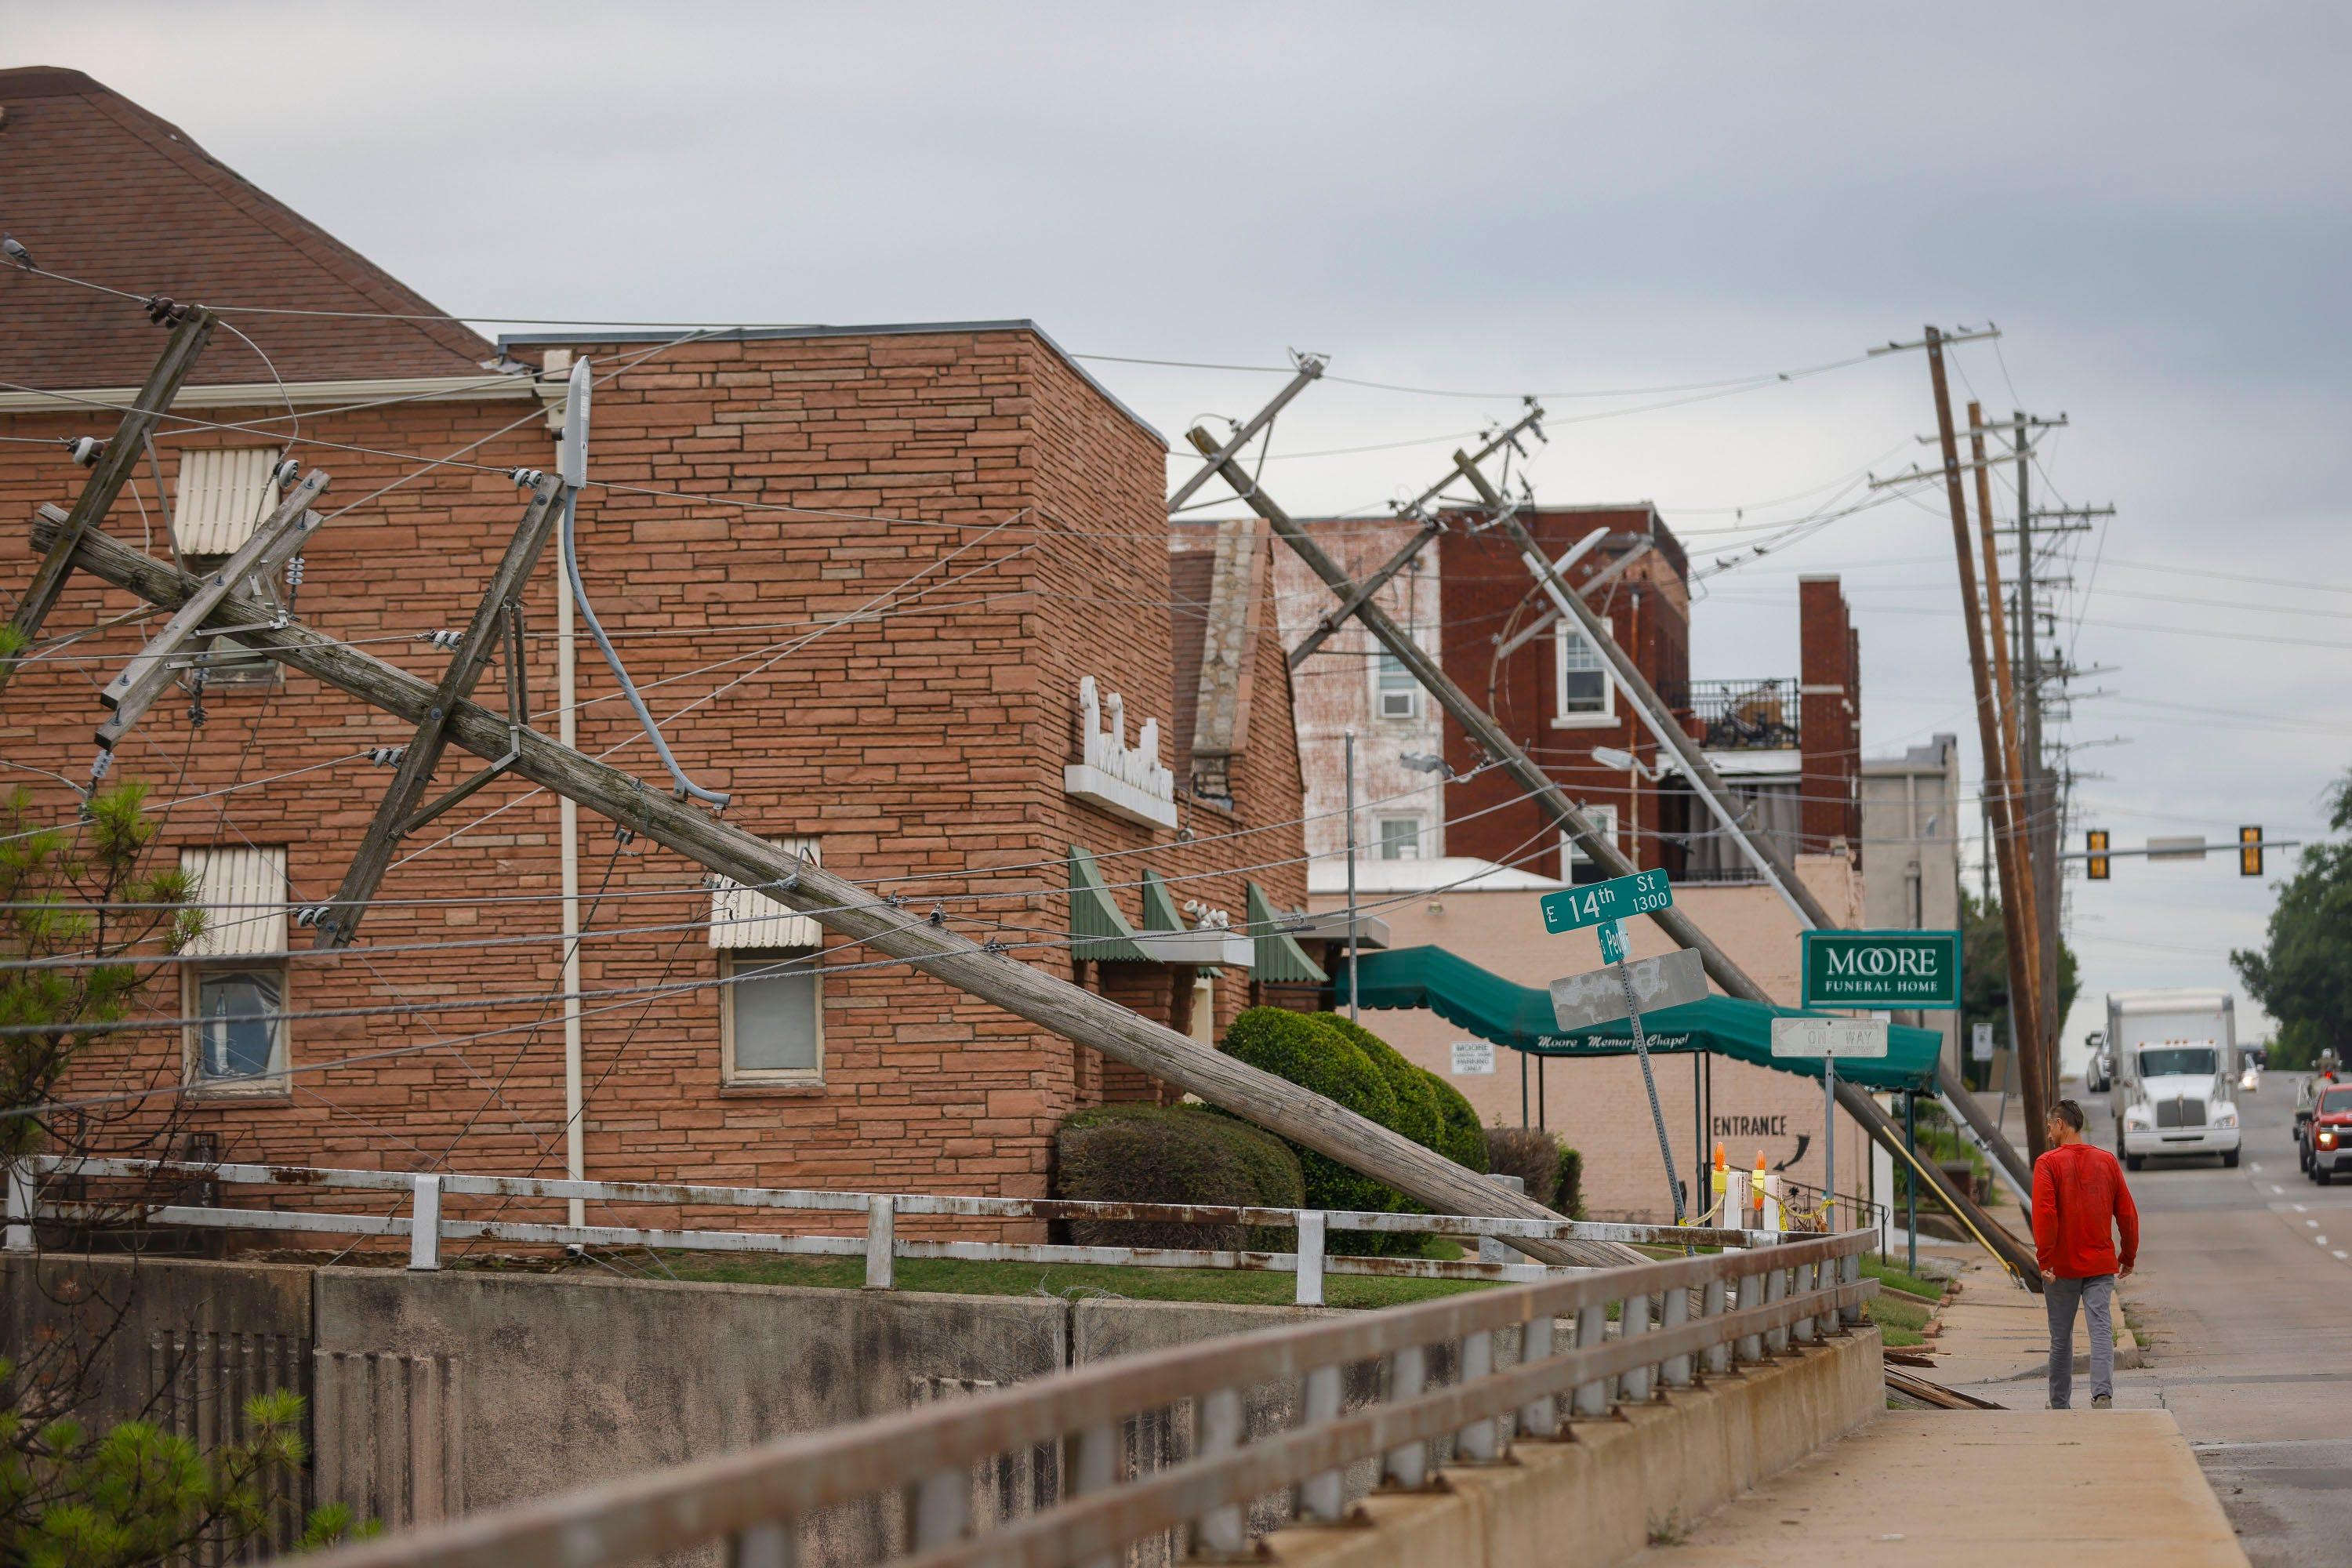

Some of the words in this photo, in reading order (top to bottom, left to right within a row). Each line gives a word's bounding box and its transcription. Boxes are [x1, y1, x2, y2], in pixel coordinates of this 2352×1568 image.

[1546, 906, 1558, 923] E
[1569, 886, 1616, 923] 14th
[1636, 873, 1656, 892] St
[1632, 891, 1668, 913] 1300
[1605, 929, 1626, 956] Peo
[1825, 947, 1938, 977] MOORE
[1825, 981, 1892, 993] FUNERAL
[1897, 981, 1938, 993] HOME
[1537, 1035, 1578, 1048] Moore
[1646, 1033, 1690, 1049] Chapel
[1807, 1030, 1837, 1045] ON
[1845, 1030, 1872, 1045] WAY
[1713, 1116, 1788, 1136] ENTRANCE
